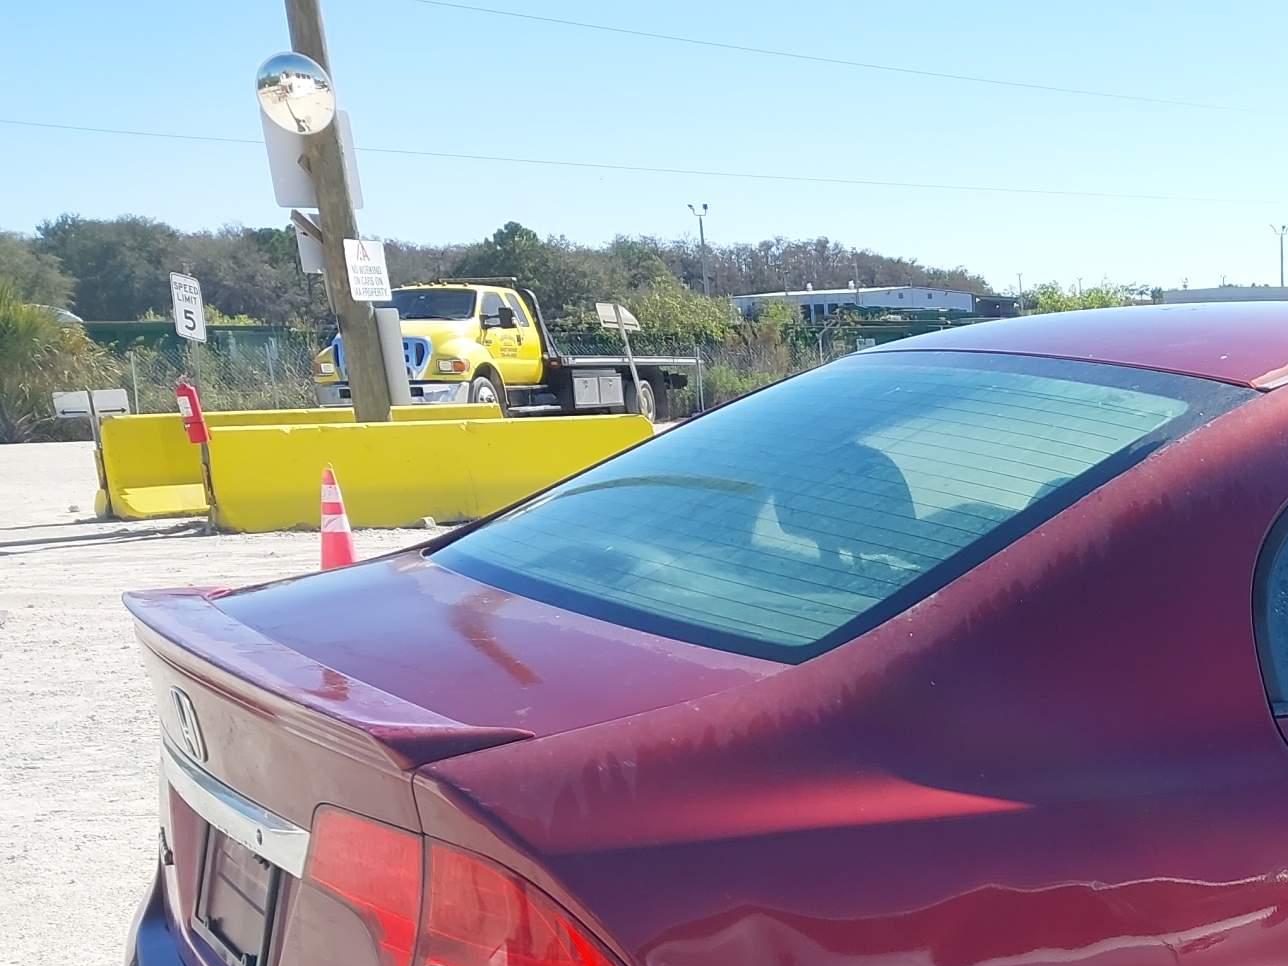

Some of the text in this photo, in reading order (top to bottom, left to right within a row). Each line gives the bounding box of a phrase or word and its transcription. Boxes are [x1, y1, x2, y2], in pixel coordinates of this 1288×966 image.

[174, 282, 199, 295] SPEED
[177, 293, 197, 305] LIMIT
[184, 309, 196, 331] 5
